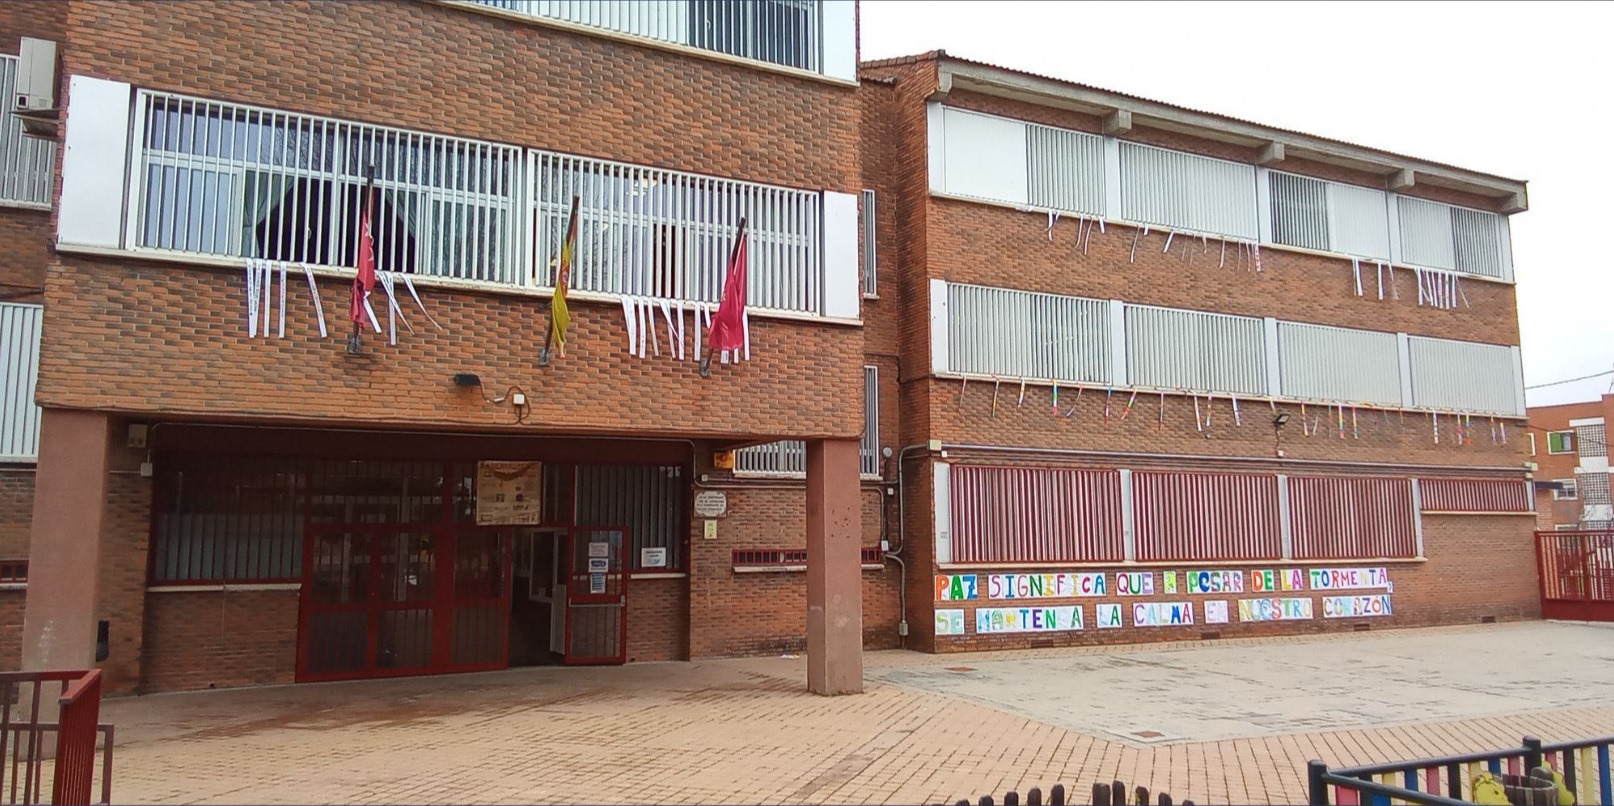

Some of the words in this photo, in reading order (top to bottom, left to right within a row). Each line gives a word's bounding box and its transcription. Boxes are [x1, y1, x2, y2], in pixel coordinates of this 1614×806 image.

[935, 574, 978, 600] PAZ
[990, 574, 1105, 598] SIGNIFICA
[1117, 573, 1153, 594] QUE
[1252, 571, 1273, 591] DE
[1282, 569, 1303, 590] LA
[936, 610, 963, 634] SE
[1134, 603, 1191, 625] CALMA
